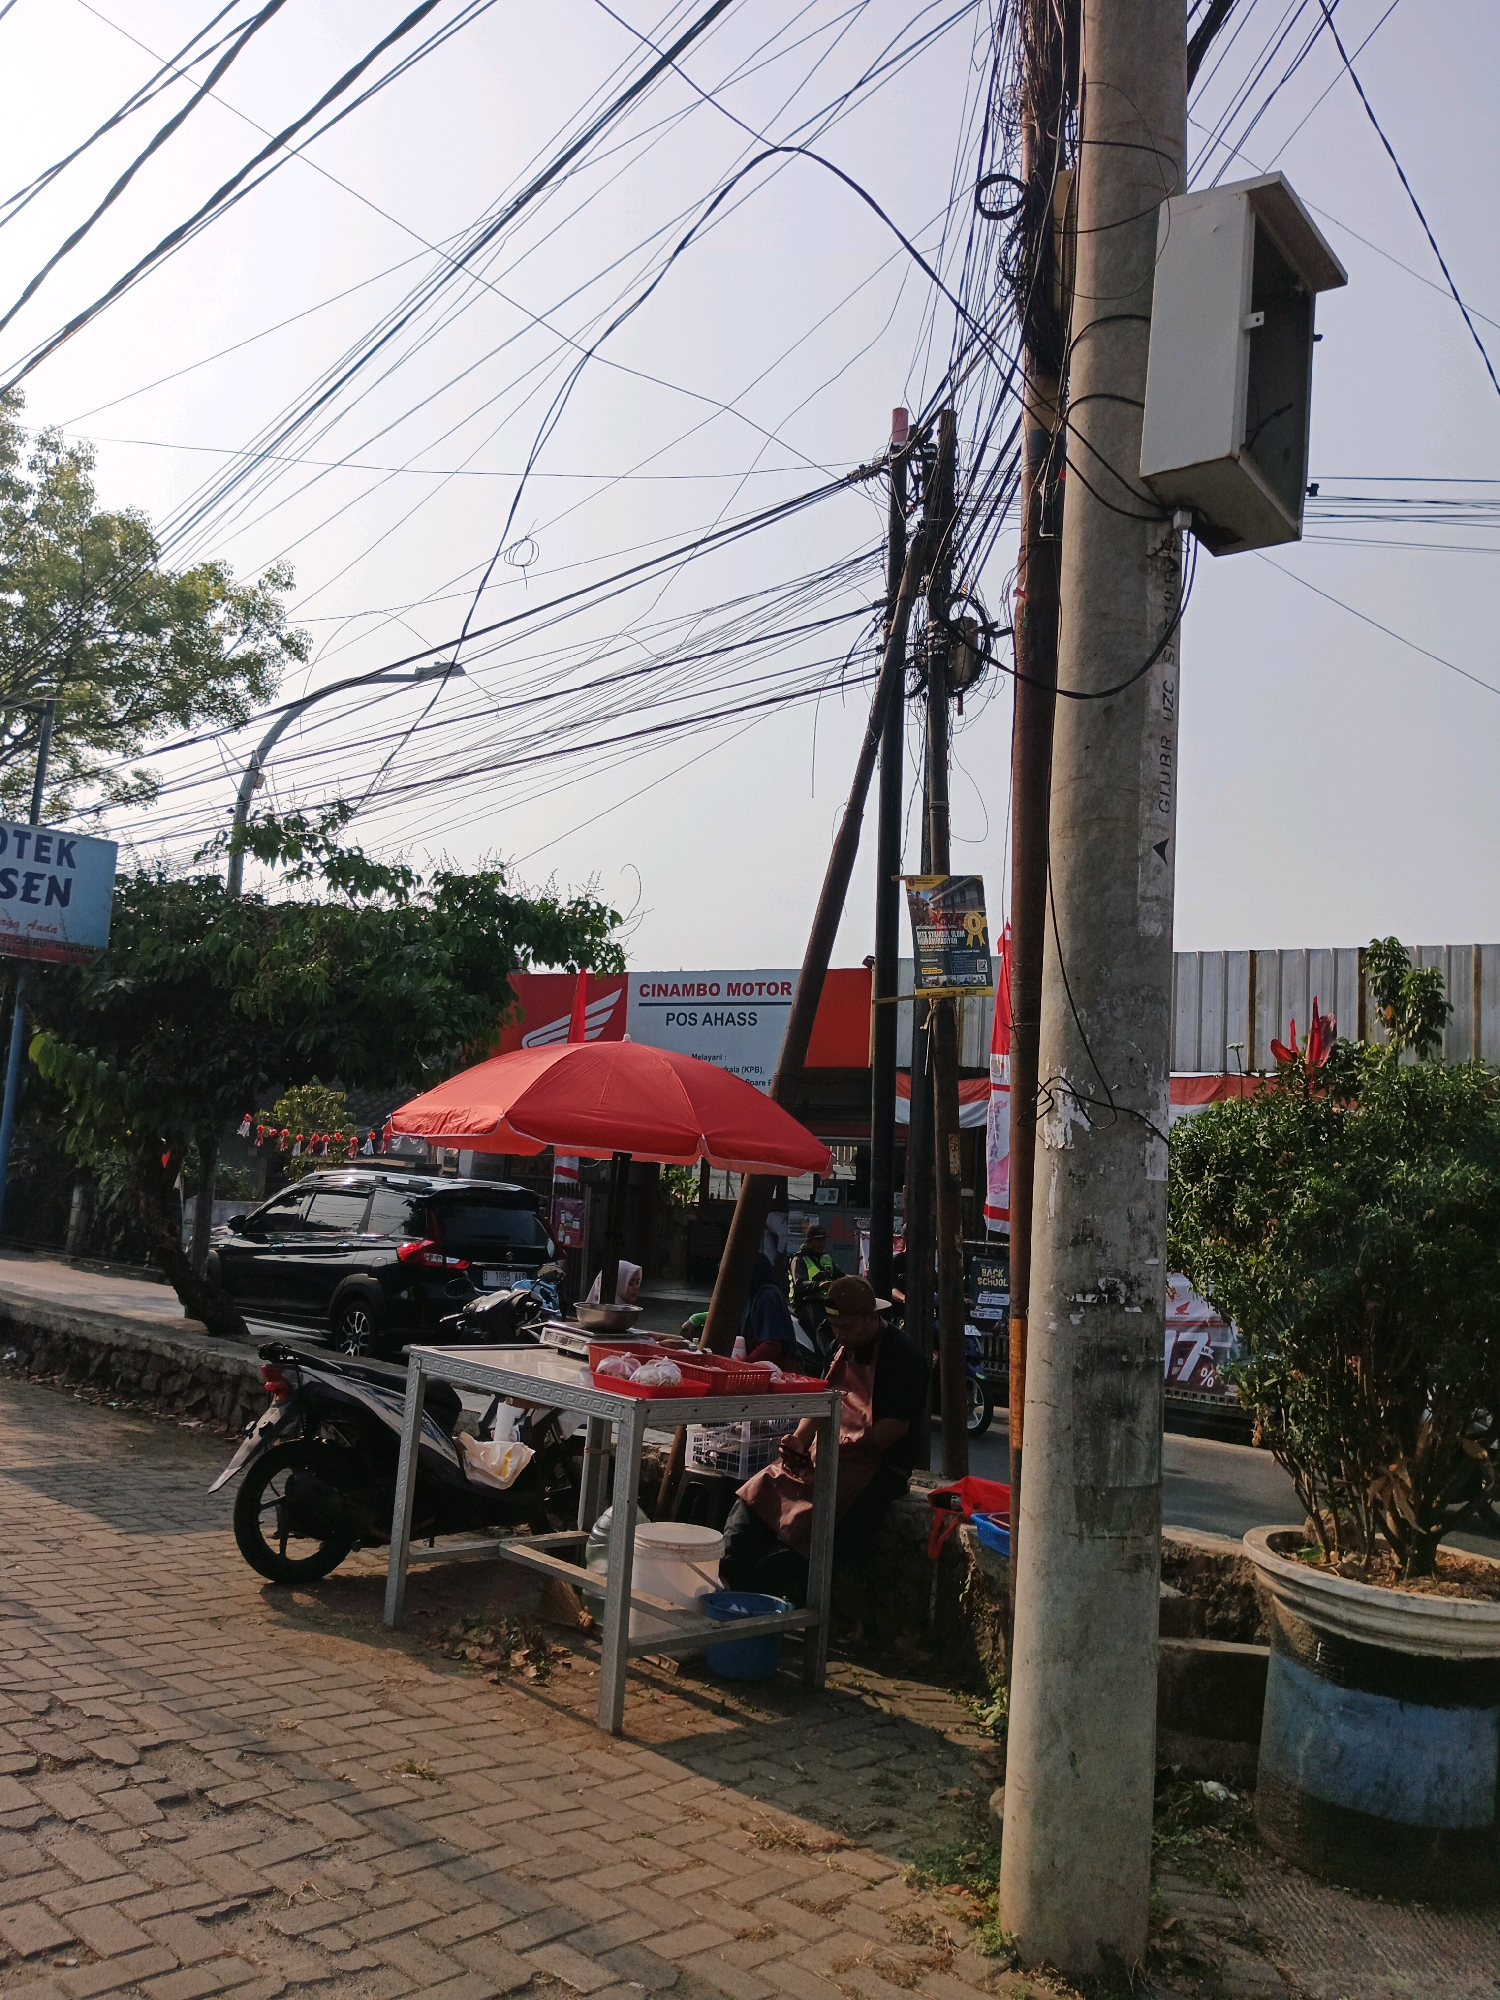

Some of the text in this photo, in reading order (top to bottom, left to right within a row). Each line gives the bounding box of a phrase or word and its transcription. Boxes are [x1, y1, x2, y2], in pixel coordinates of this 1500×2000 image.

[0, 867, 73, 908] SEN
[55, 943, 94, 954] BANDUN
[639, 981, 793, 997] CINAMBO MOTOR
[665, 1011, 759, 1027] POS AHASS
[691, 1053, 722, 1062] Melayani
[981, 1268, 1004, 1278] BACK
[977, 1276, 1008, 1286] SCHOOL
[1200, 1367, 1215, 1388] %
